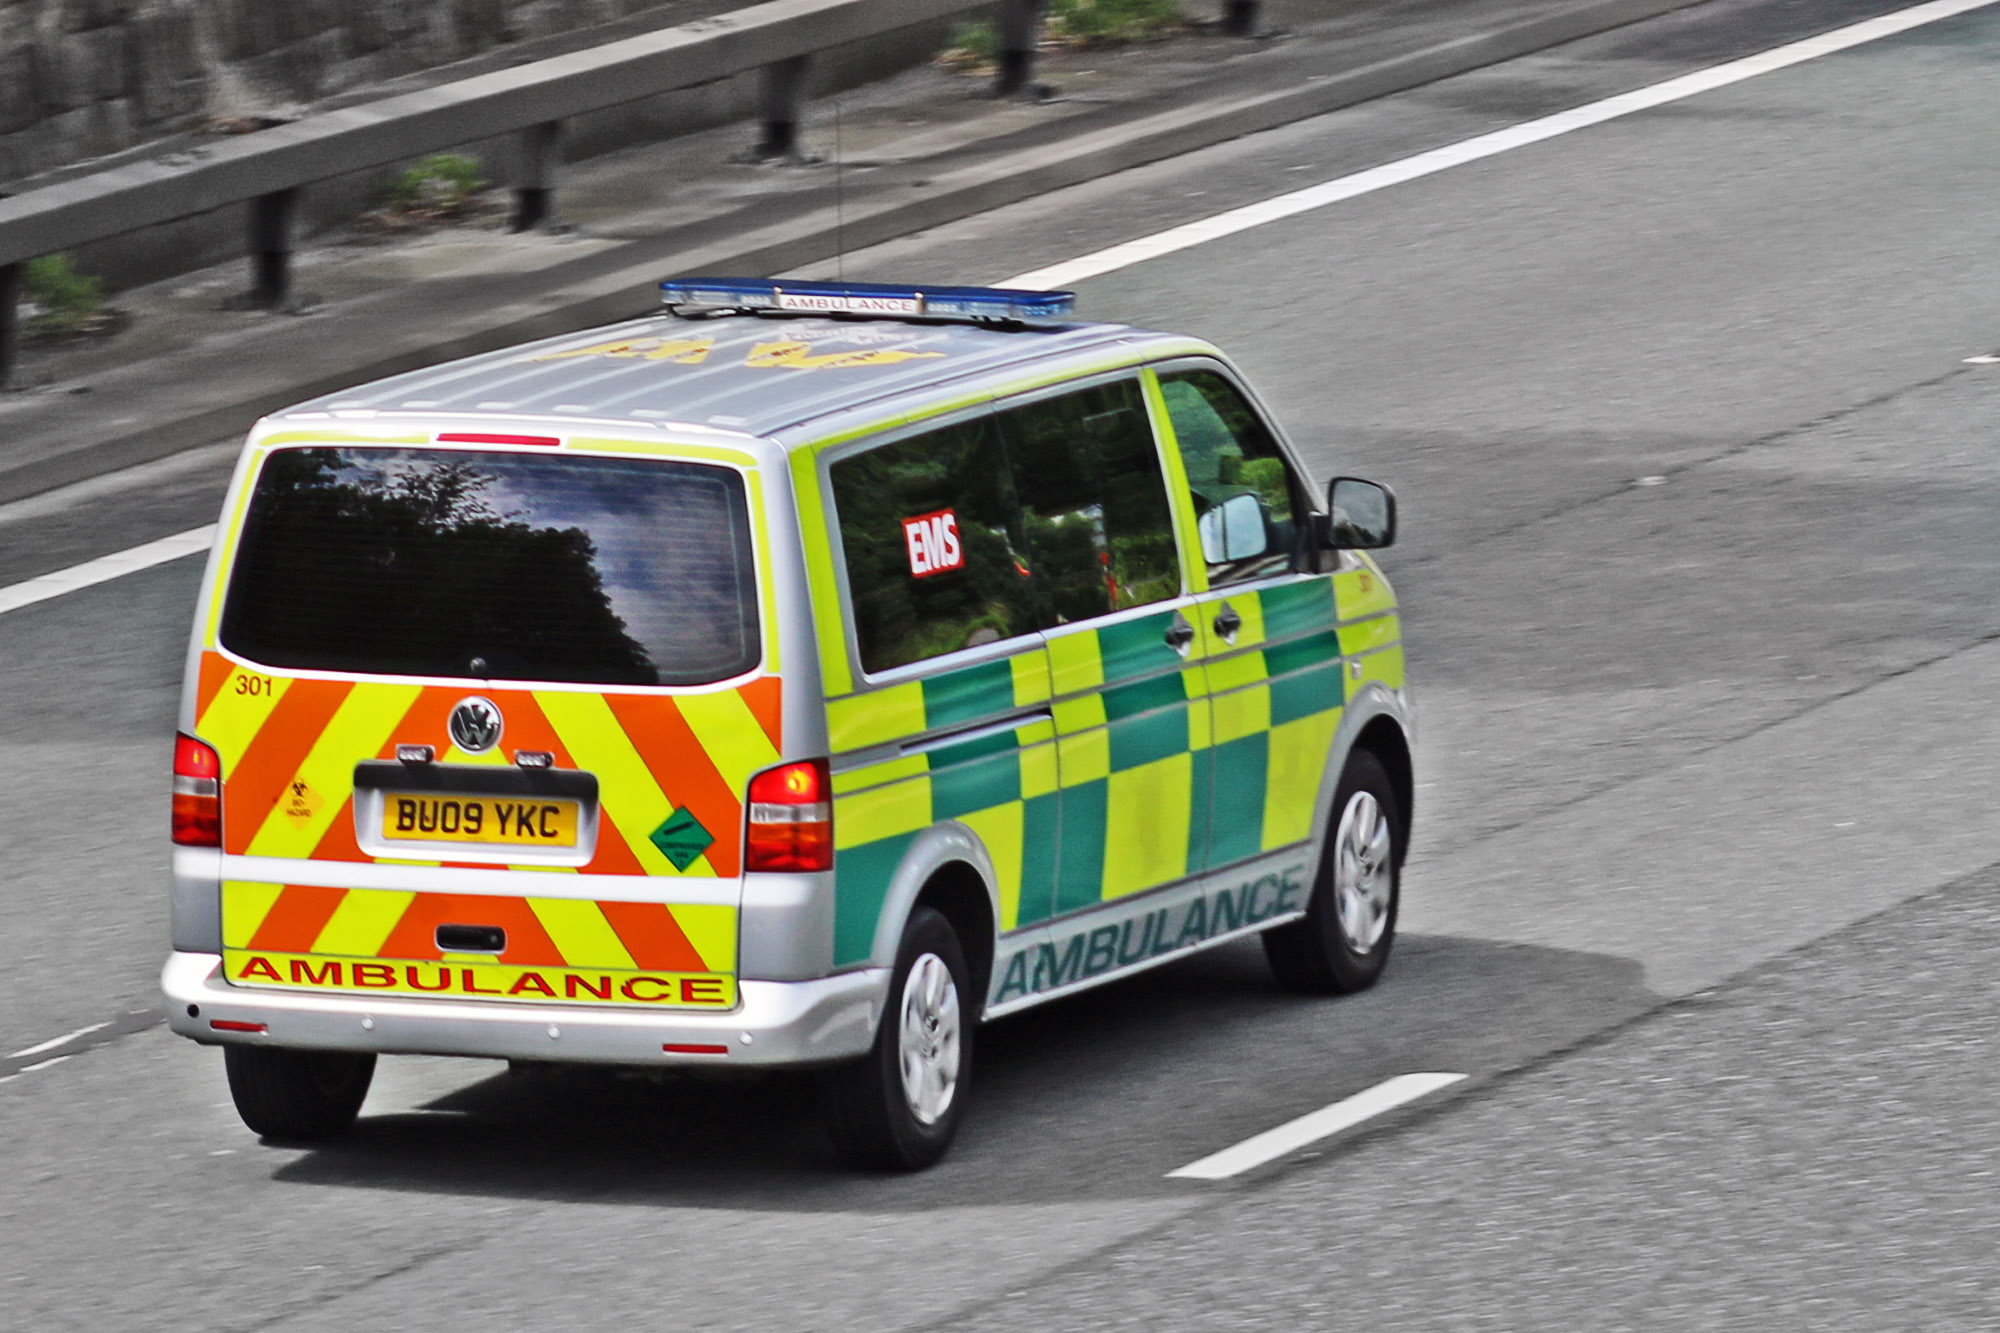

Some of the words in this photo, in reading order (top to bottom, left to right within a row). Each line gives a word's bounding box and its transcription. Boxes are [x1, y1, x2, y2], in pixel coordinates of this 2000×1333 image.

[787, 297, 914, 312] AMBULANCE
[905, 513, 960, 574] EMS
[235, 675, 272, 697] 301
[396, 799, 483, 834] BU09
[495, 803, 561, 838] YKC
[994, 863, 1306, 1003] AMBULANCE
[238, 956, 726, 1003] AMBULANCE
